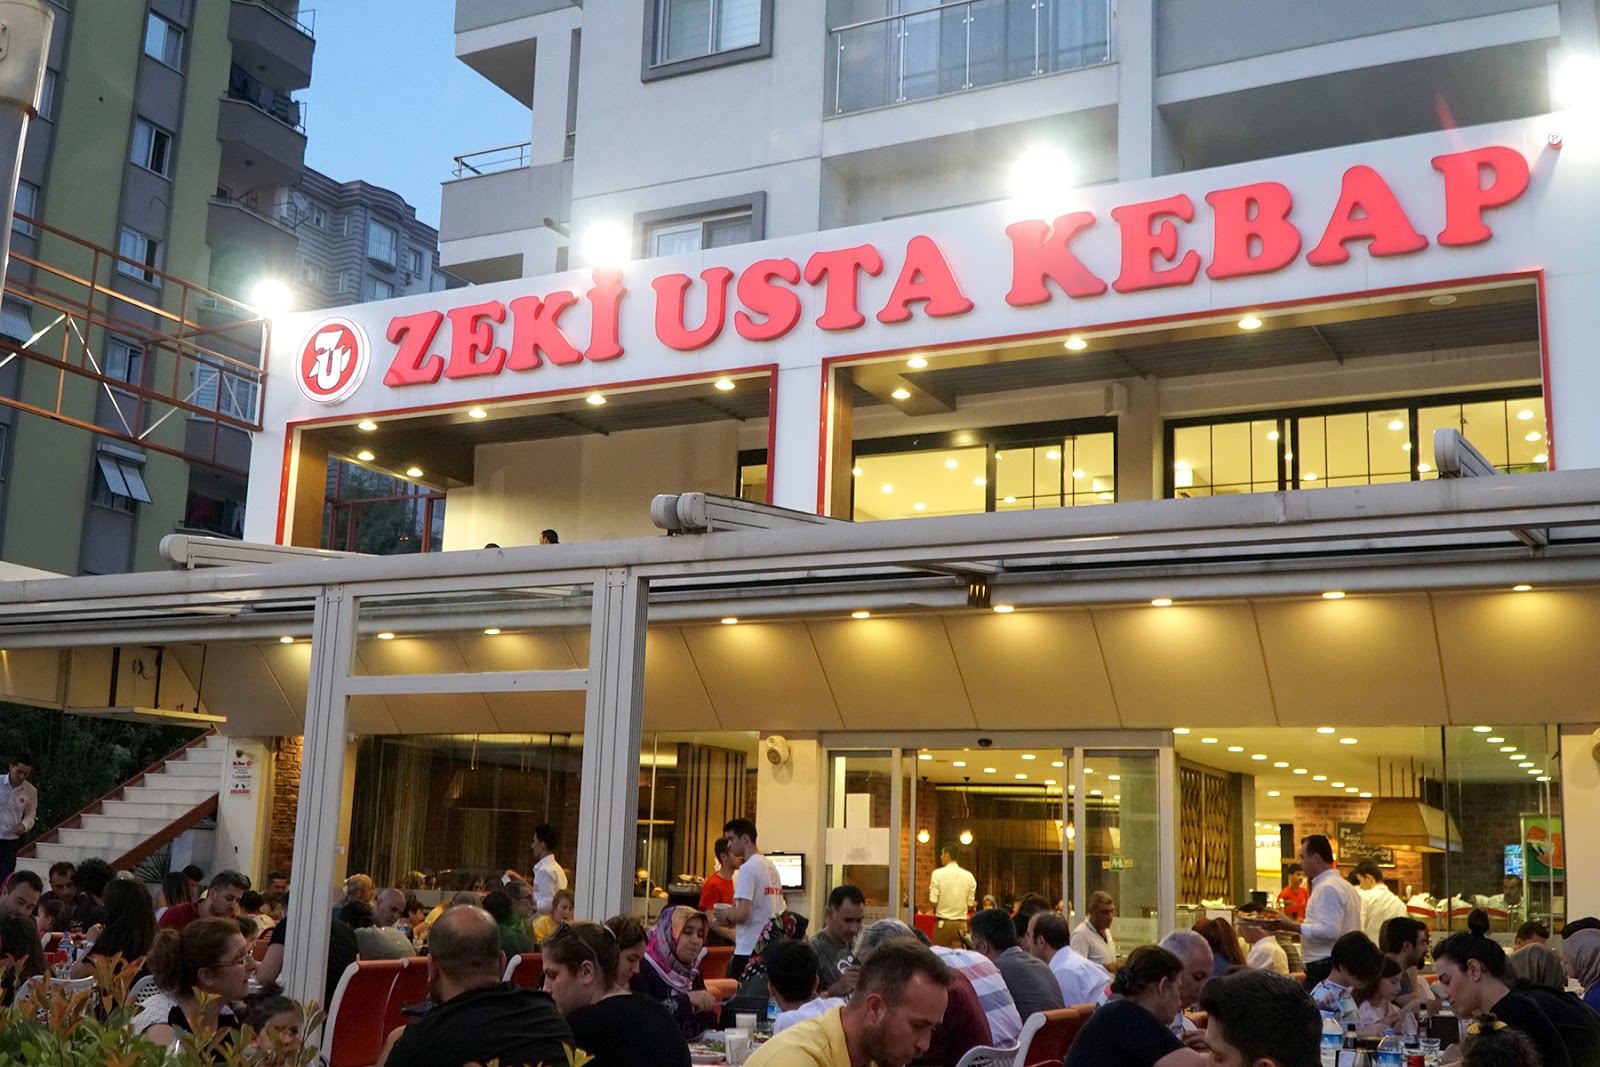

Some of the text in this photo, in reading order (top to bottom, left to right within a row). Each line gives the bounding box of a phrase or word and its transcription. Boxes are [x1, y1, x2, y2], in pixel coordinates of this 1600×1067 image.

[384, 267, 626, 388] ZEKİ
[652, 236, 976, 351] USTA
[1005, 145, 1531, 308] KEBAP
